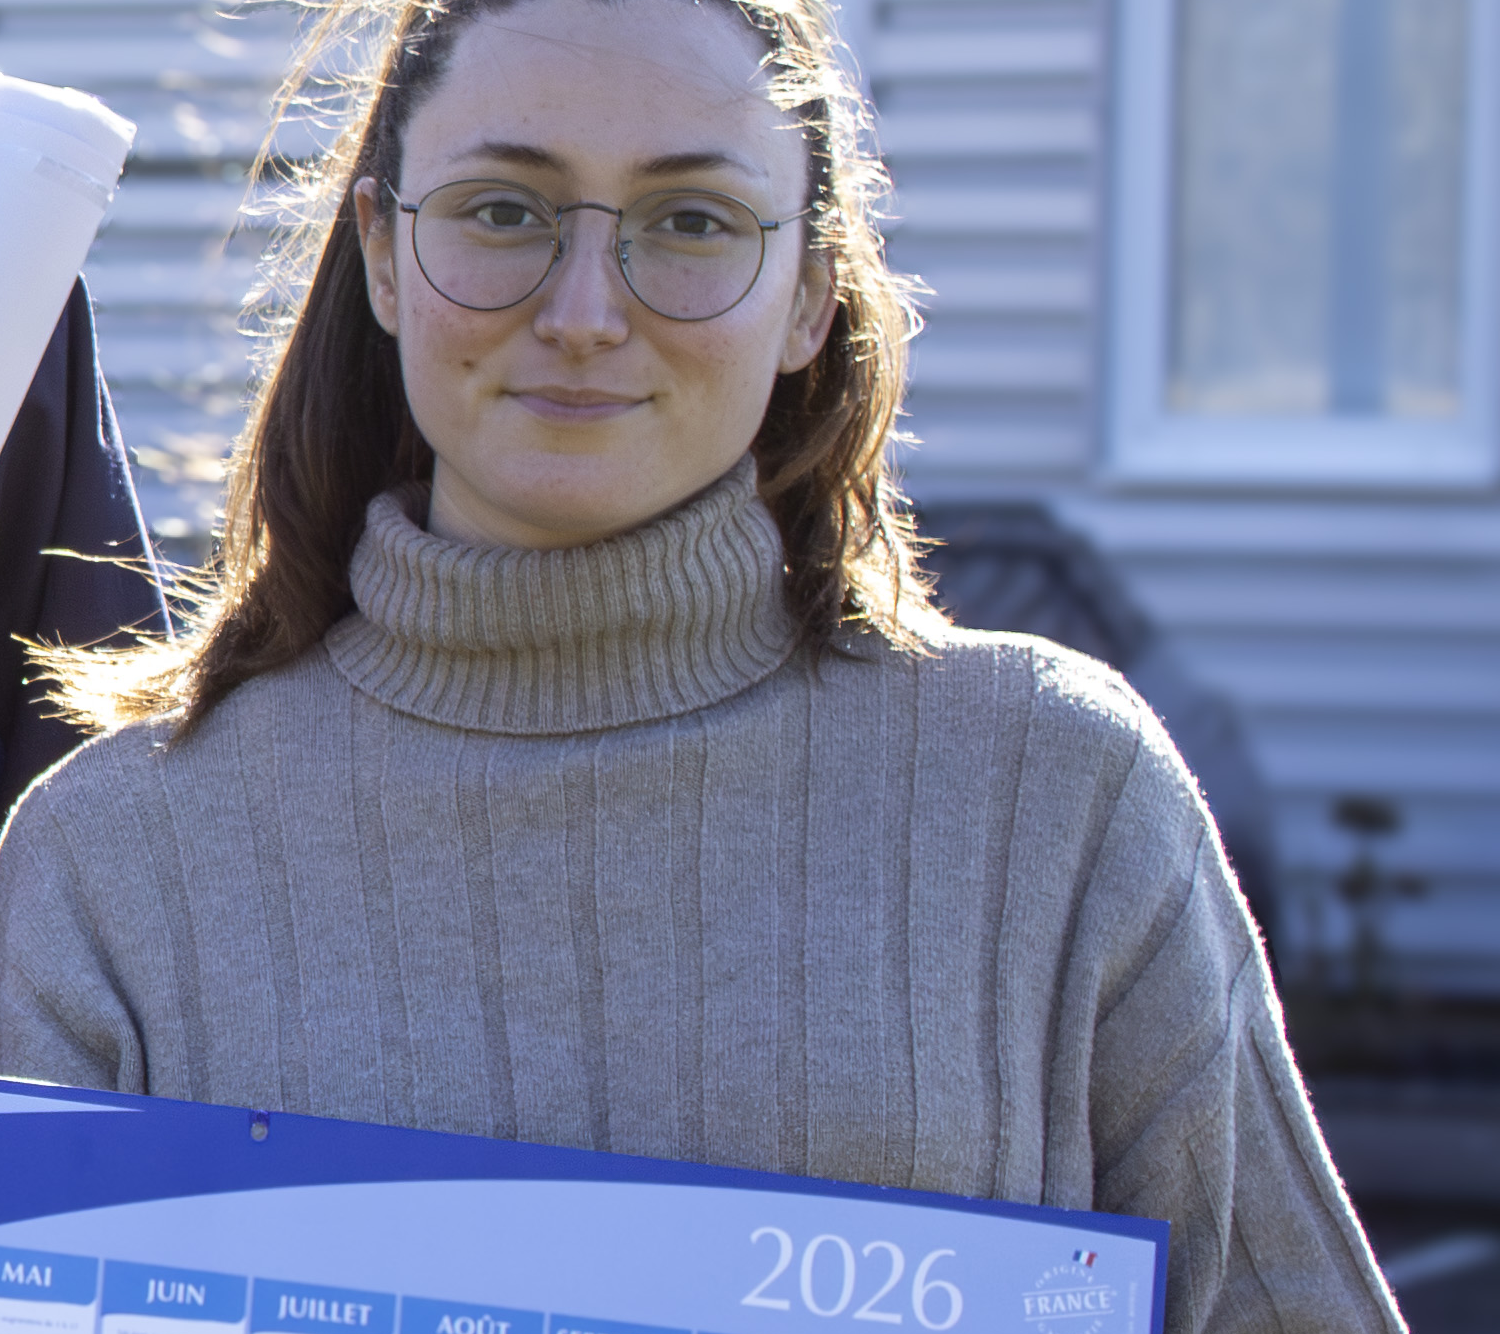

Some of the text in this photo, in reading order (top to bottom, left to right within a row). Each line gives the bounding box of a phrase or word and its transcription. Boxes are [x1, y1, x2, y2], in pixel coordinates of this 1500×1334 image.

[0, 1260, 52, 1288] MAI
[740, 1226, 965, 1332] 2026
[146, 1277, 207, 1307] JUIN
[1024, 1290, 1111, 1316] FRANCE
[277, 1293, 373, 1327] JUILLET
